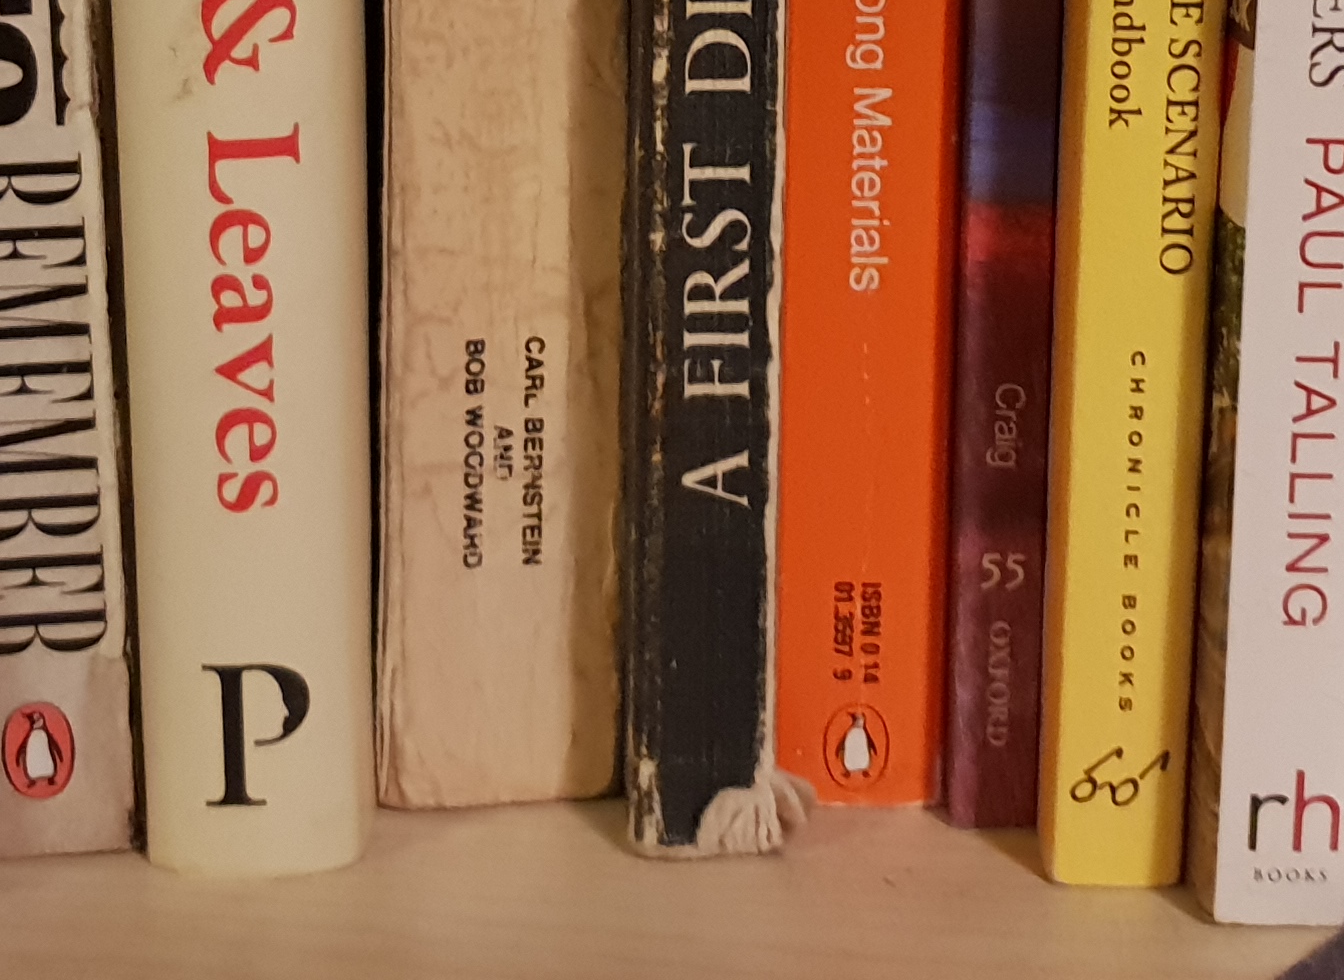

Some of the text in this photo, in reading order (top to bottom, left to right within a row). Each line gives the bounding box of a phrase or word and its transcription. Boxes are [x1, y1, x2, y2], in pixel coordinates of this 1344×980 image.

[846, 85, 895, 294] Materials
[1156, 37, 1203, 277] SCENARIO
[204, 123, 304, 515] Leaves
[679, 140, 754, 401] FIRST
[462, 338, 487, 570] BOB WOODWARD
[492, 424, 515, 482] AND
[521, 335, 547, 566] CARL BERNSTEIN
[679, 449, 752, 513] A
[985, 381, 1029, 469] Craig
[1280, 339, 1343, 631] TALLING
[978, 550, 1028, 592] 55
[1116, 349, 1150, 717] CHRONICLE BOOKS
[860, 582, 882, 636] ISBN
[201, 663, 313, 809] P
[983, 619, 1015, 748] OXFORD
[1245, 768, 1344, 853] rh
[1251, 865, 1330, 887] BOOKS
